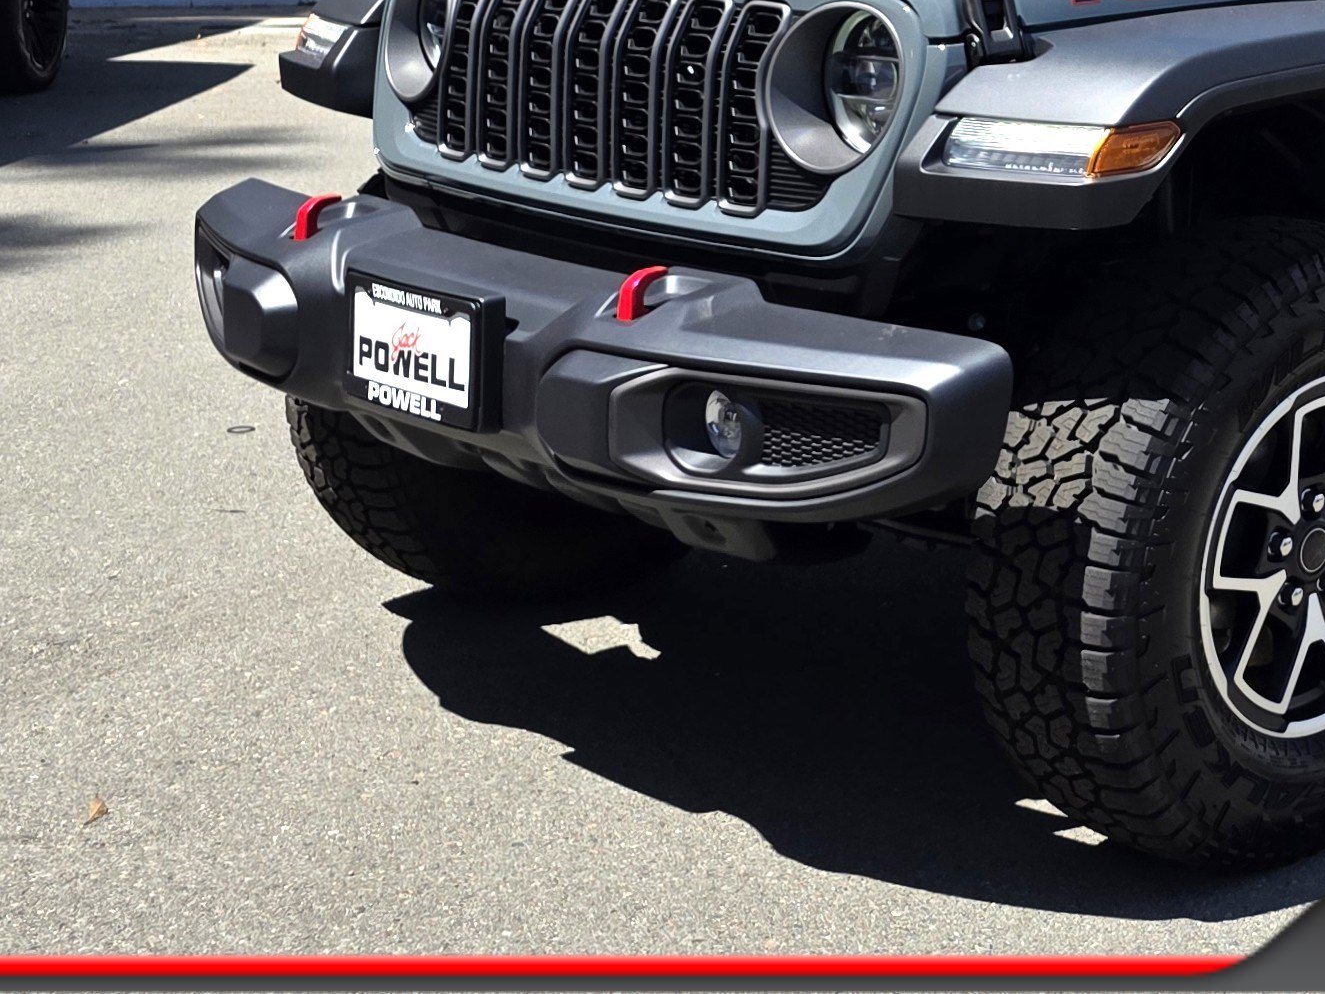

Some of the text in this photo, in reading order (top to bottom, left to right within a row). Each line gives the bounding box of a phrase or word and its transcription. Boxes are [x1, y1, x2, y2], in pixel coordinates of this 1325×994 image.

[406, 292, 423, 310] AUTO
[391, 322, 421, 361] Jack
[359, 335, 465, 392] POWELL
[367, 380, 442, 422] POWELL
